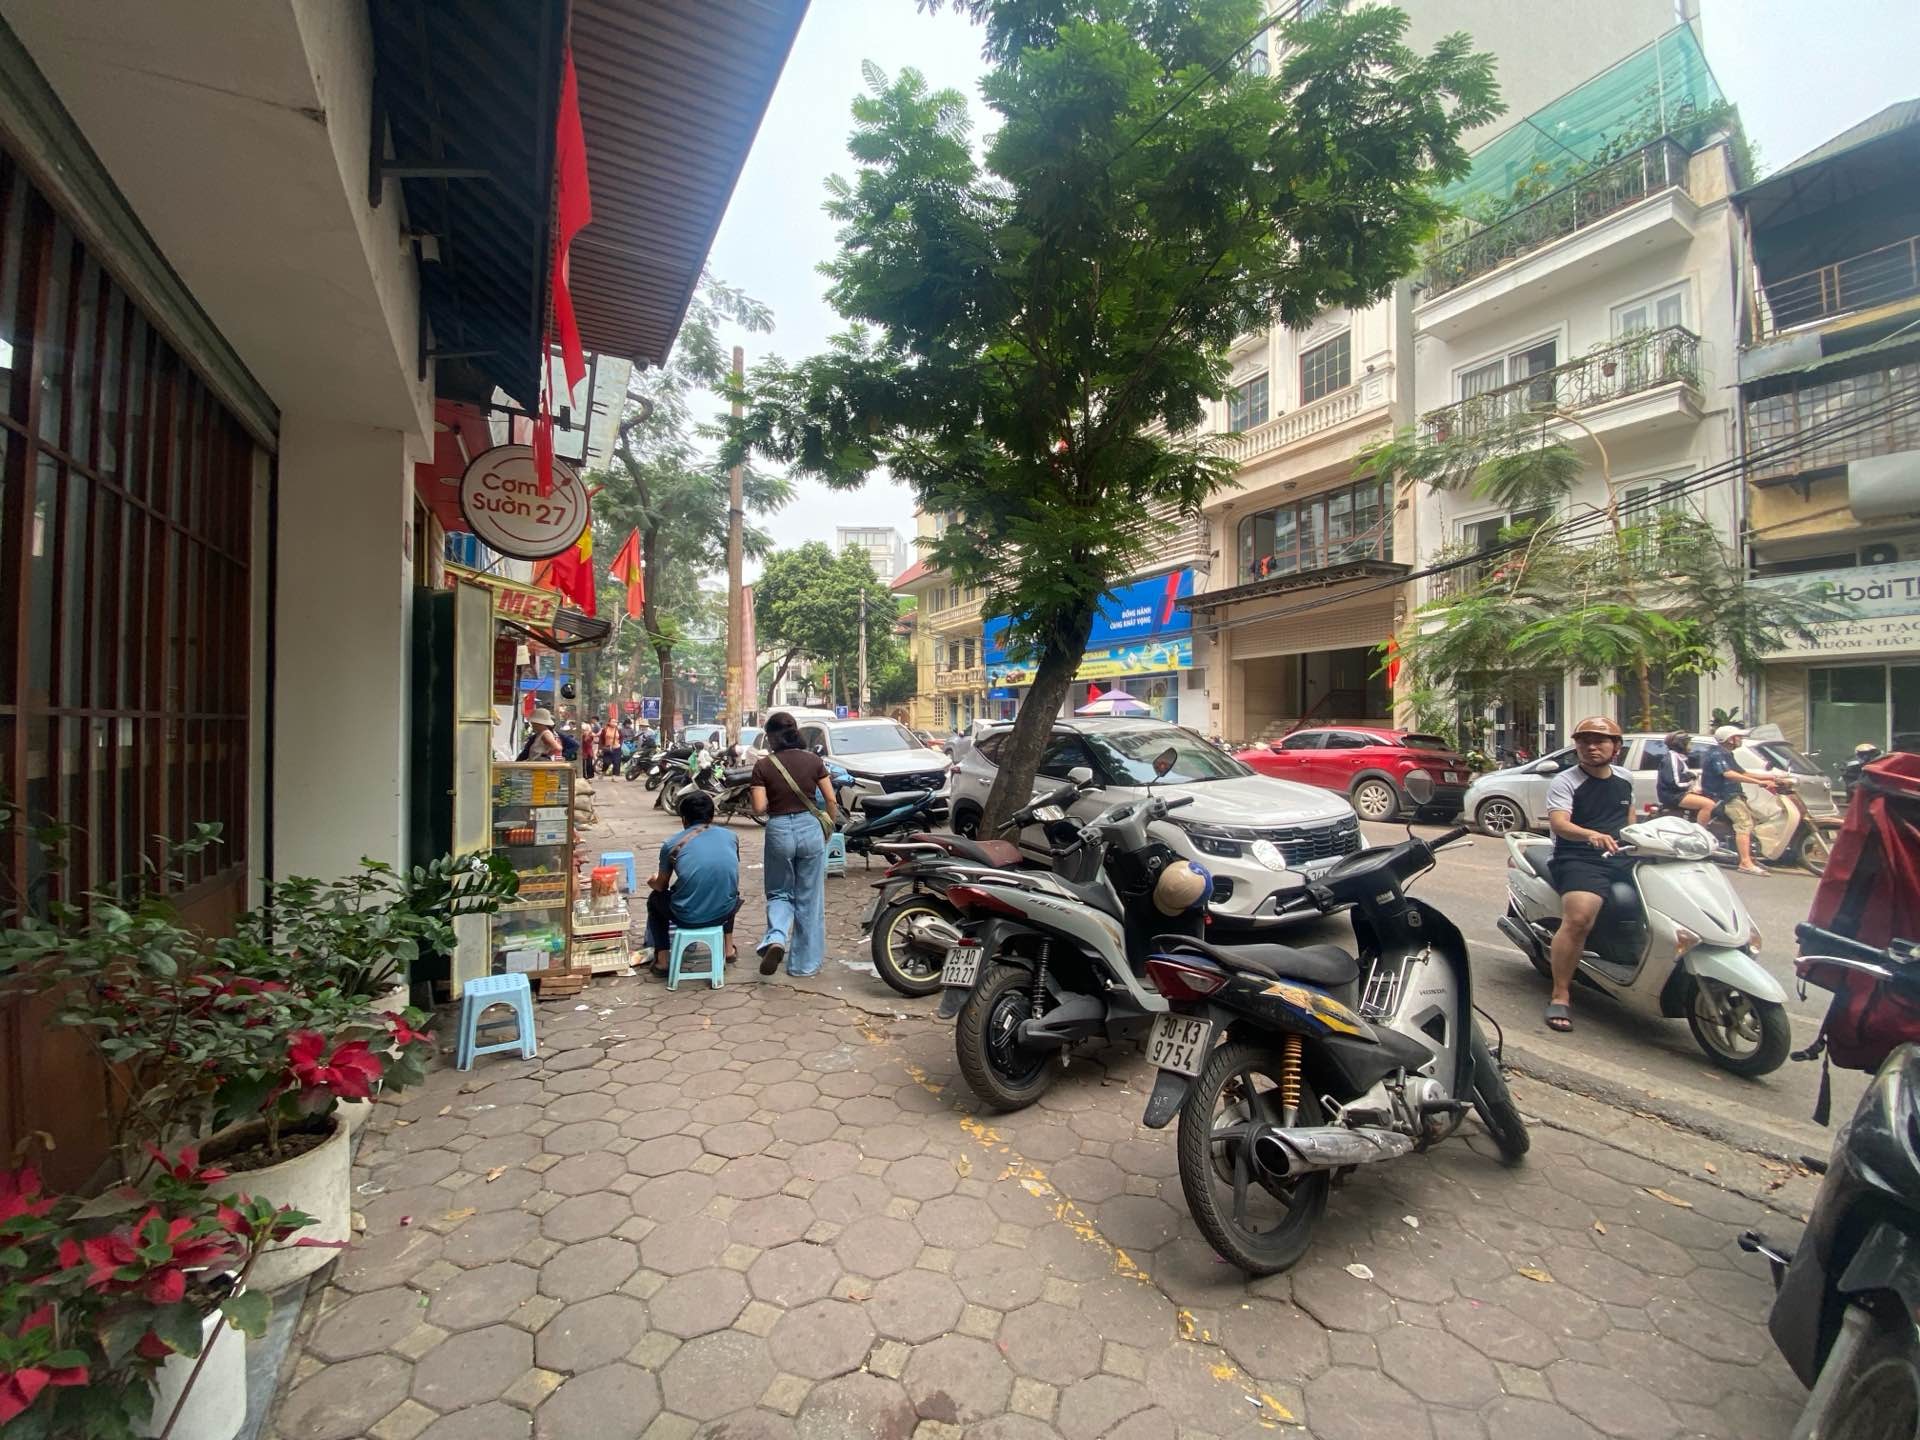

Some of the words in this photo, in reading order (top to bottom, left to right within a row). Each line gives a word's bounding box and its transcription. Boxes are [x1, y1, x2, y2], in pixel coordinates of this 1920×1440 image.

[482, 472, 538, 496] Cơm
[472, 492, 530, 516] Sườn
[536, 504, 566, 526] 27
[944, 966, 974, 983] 123.27
[1160, 1017, 1201, 1045] 30-K3
[1152, 1040, 1194, 1071] 9754
